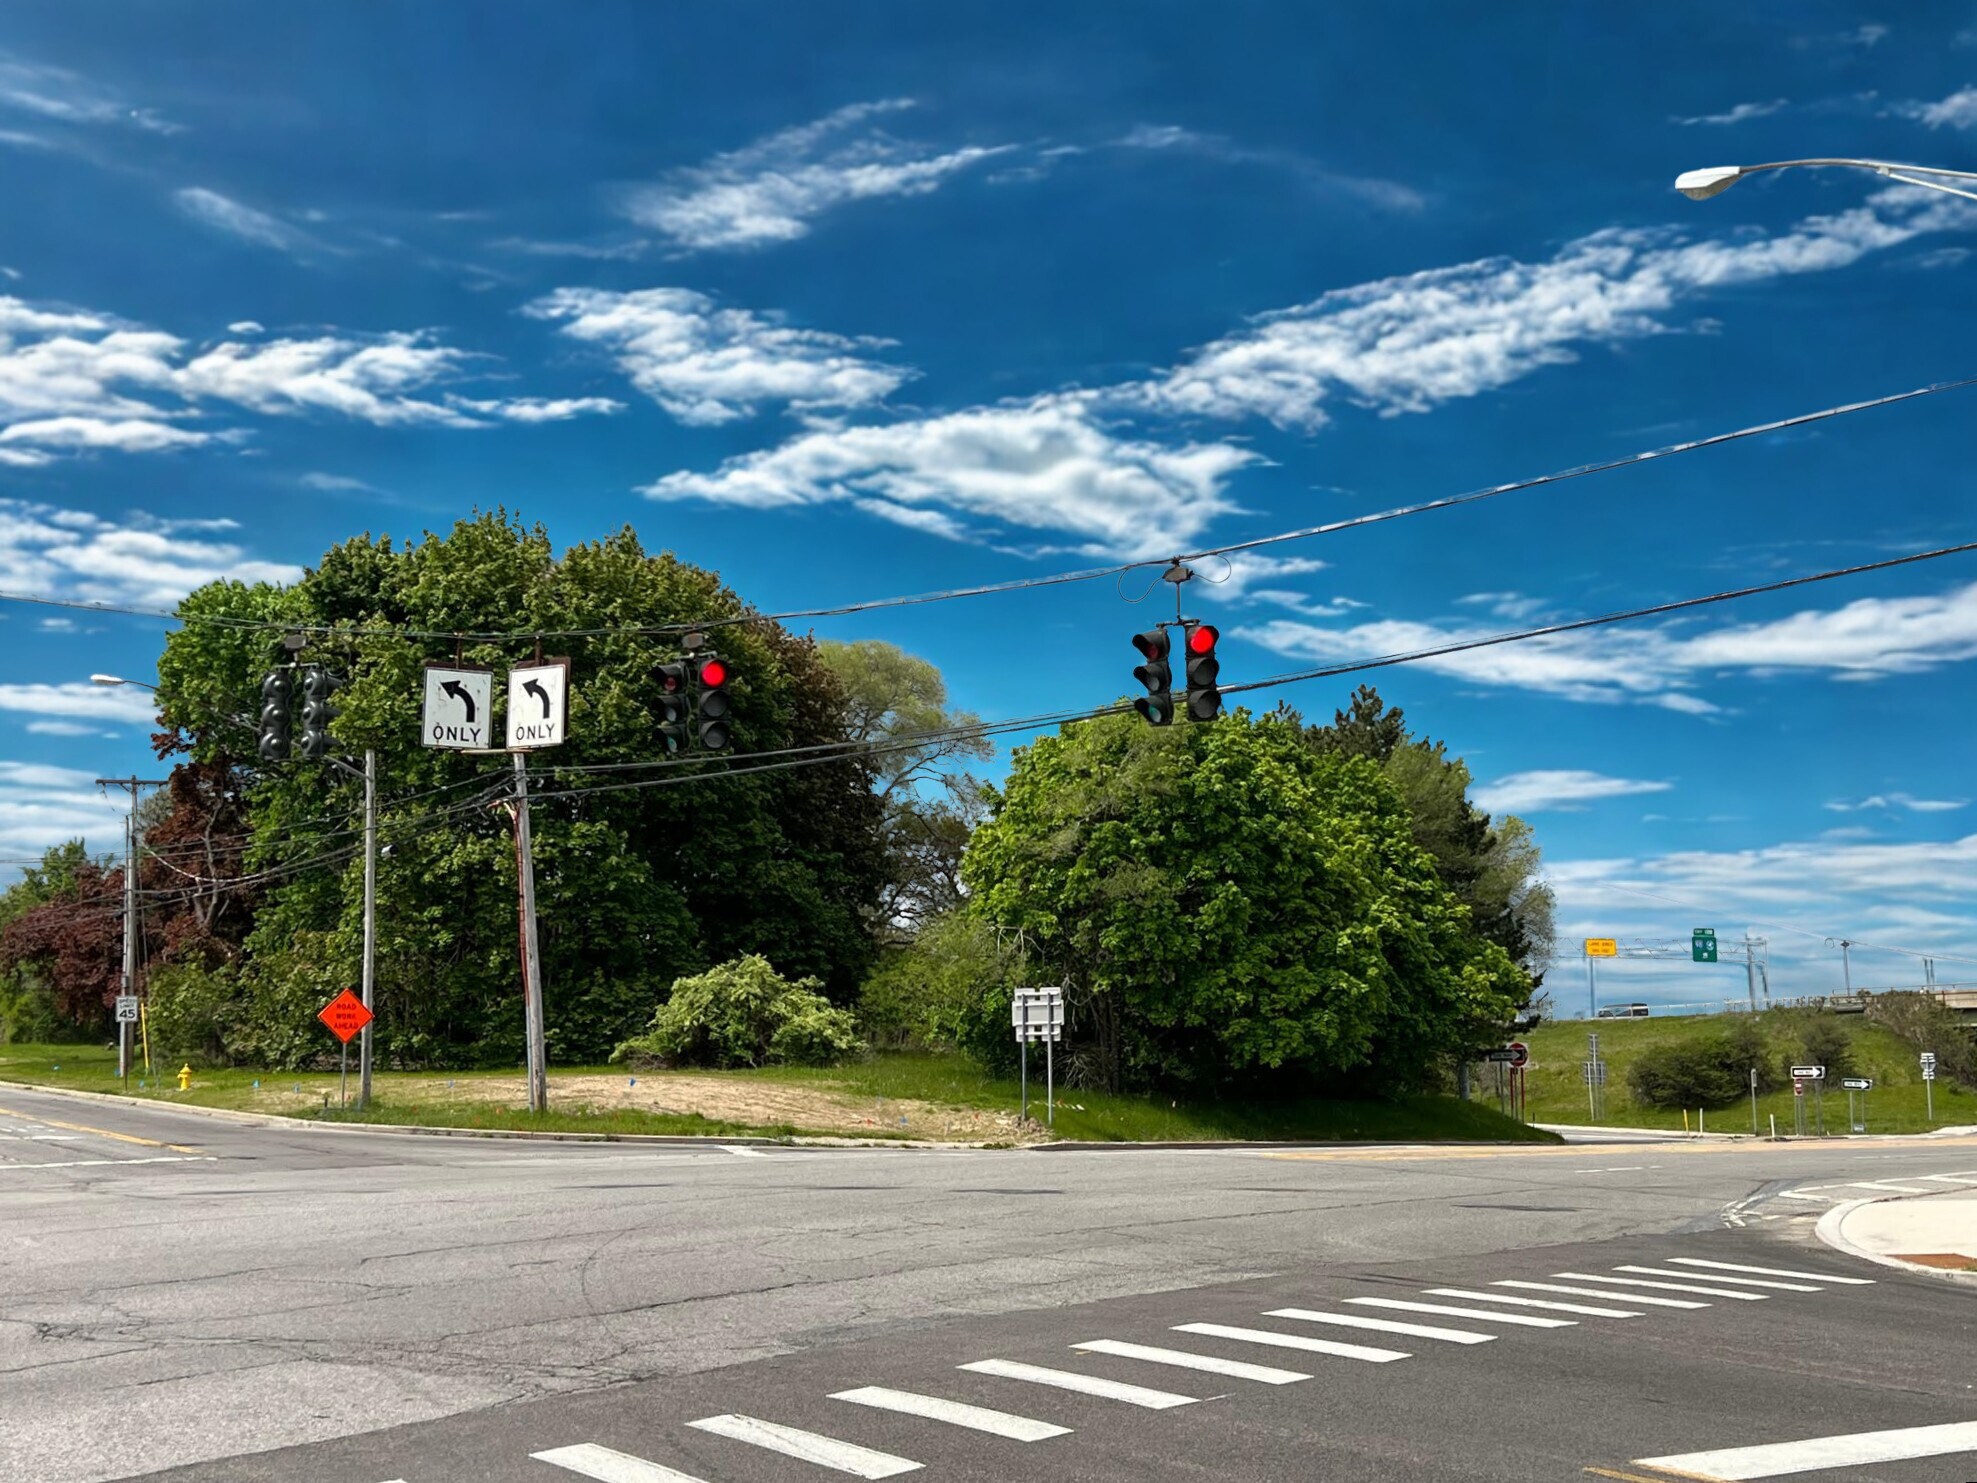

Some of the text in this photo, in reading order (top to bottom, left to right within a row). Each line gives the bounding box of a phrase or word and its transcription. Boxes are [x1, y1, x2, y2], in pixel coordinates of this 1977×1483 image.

[433, 725, 481, 743] ONLY
[516, 723, 555, 740] ONLY
[119, 1009, 135, 1018] 45
